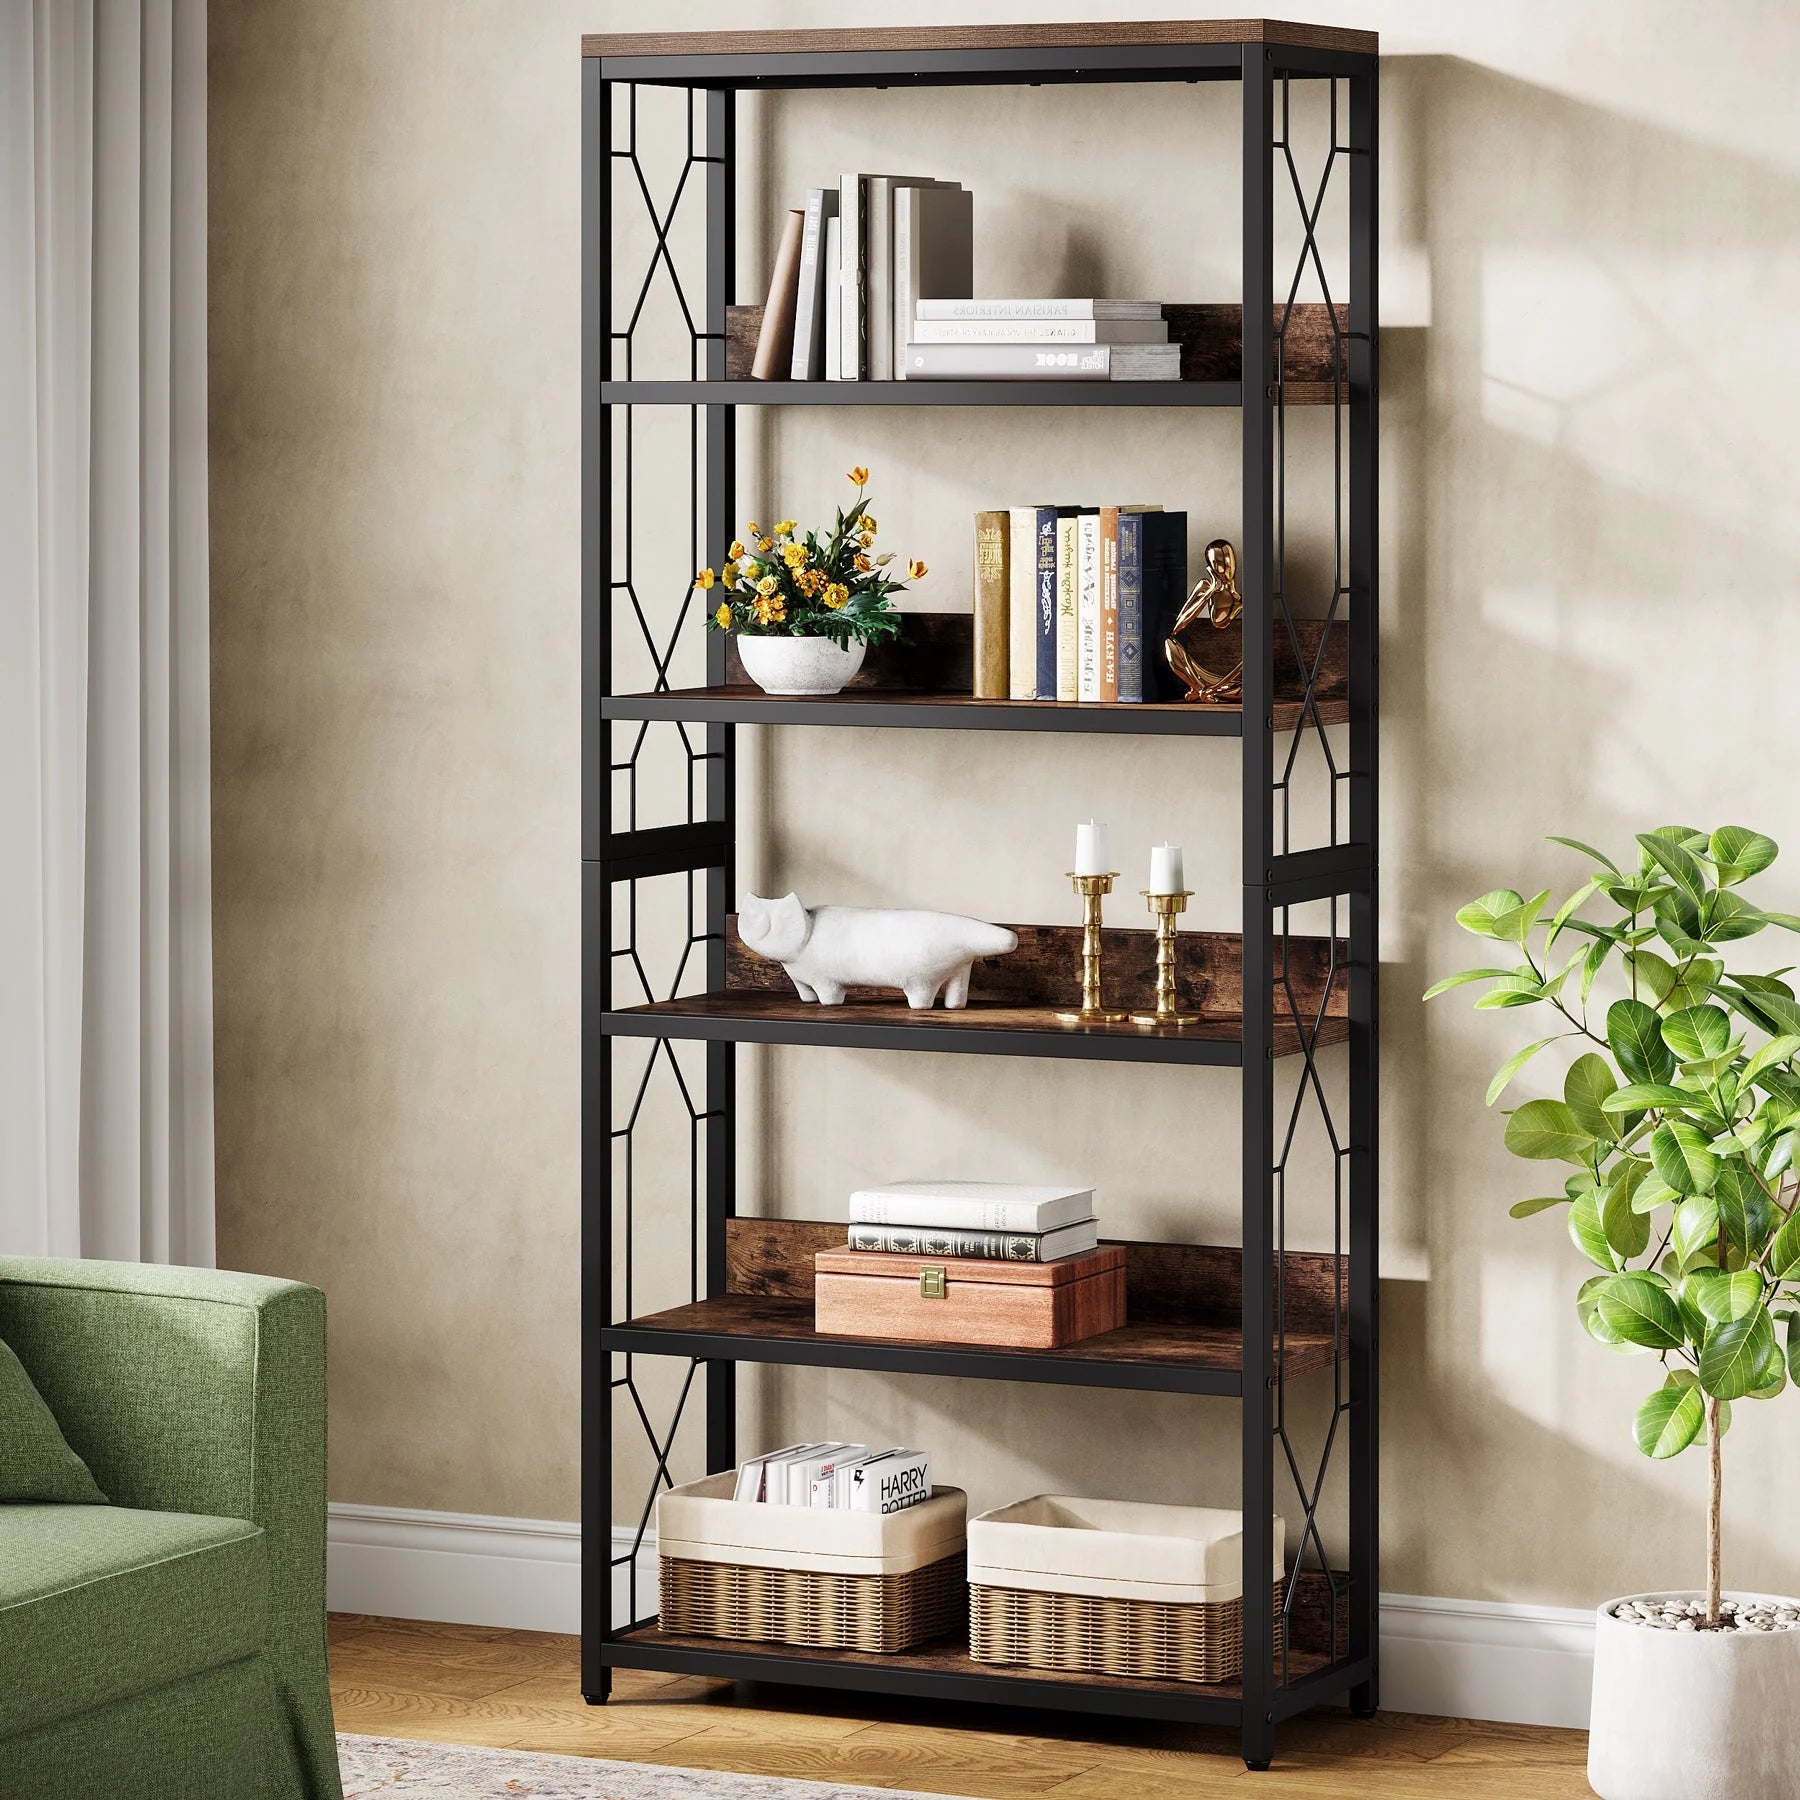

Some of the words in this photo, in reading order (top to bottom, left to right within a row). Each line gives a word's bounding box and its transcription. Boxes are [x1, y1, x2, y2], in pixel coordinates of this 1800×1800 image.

[1062, 526, 1074, 568] жизни
[1061, 571, 1074, 617] Жажда
[881, 1464, 927, 1500] HARRY
